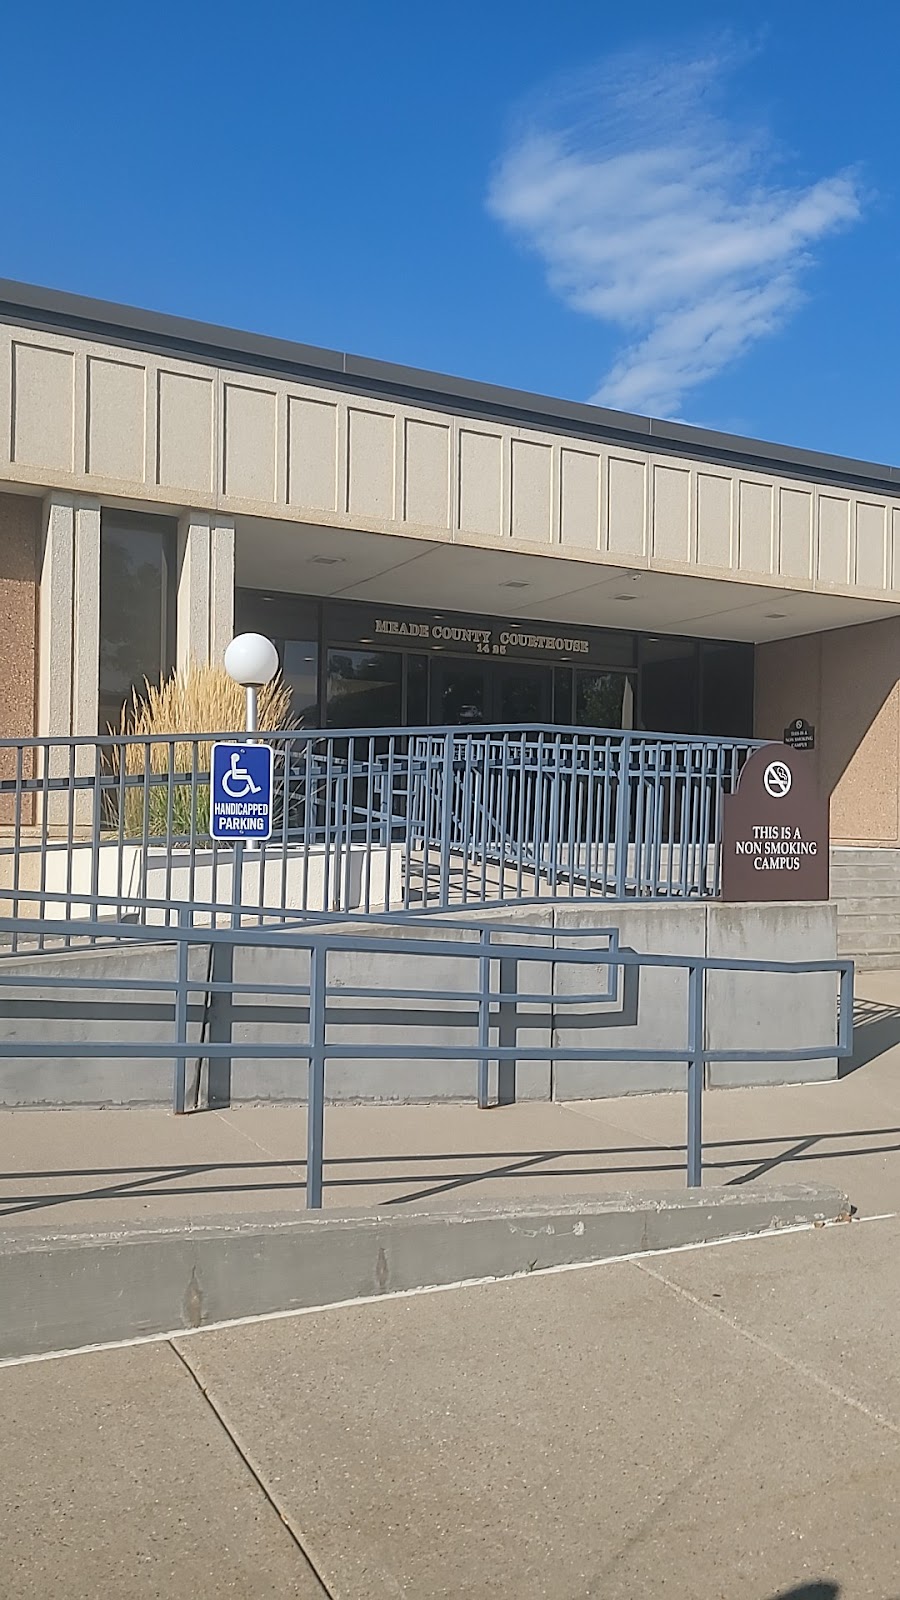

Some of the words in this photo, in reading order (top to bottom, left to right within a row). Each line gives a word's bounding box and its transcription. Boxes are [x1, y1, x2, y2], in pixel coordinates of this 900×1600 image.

[375, 620, 429, 637] MEADE
[432, 627, 491, 643] COUNTY
[500, 632, 589, 652] COURTHOUSE
[215, 803, 268, 815] HANDICAPPED
[219, 817, 264, 830] PARKING
[752, 826, 778, 839] THIS
[780, 827, 791, 839] IS
[793, 827, 801, 839] A
[735, 841, 762, 854] NON
[764, 841, 817, 854] SMOKING
[754, 857, 800, 870] CAMPUS
